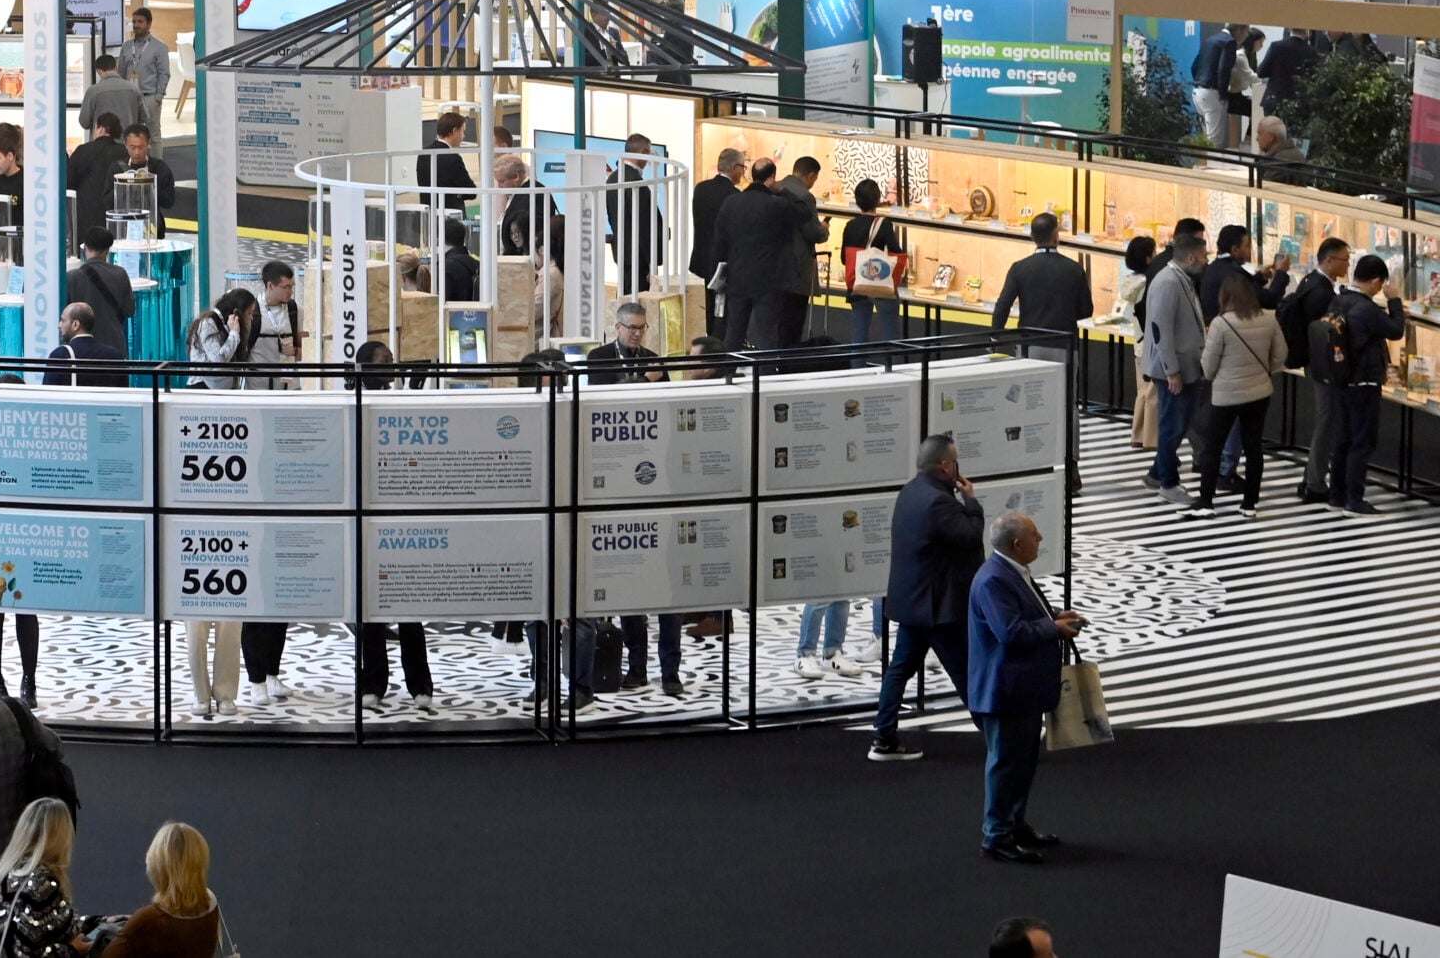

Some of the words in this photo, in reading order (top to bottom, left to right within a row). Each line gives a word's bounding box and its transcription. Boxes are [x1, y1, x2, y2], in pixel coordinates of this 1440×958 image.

[33, 10, 49, 153] AWARDS
[1006, 64, 1077, 85] engagée
[342, 243, 356, 303] TOUR
[378, 416, 414, 428] PRIX
[418, 416, 450, 428] TOP
[591, 411, 630, 426] PRIX
[635, 409, 658, 424] DU
[197, 422, 249, 441] 2100
[378, 429, 391, 446] 3
[398, 429, 450, 446] PAYS
[591, 424, 659, 442] PUBLIC
[12, 439, 88, 452] INNOVATION
[180, 441, 249, 450] INNOVATIONS
[2, 450, 25, 459] SIAL
[27, 450, 59, 460] PARIS
[61, 451, 89, 462] 2024
[180, 454, 248, 482] 560
[68, 526, 90, 539] TO
[180, 529, 197, 537] FOR
[197, 529, 215, 537] THIS
[378, 528, 396, 537] TOP
[398, 528, 404, 536] 3
[406, 528, 450, 536] COUNTRY
[591, 523, 614, 535] THE
[617, 521, 659, 534] PUBLIC
[7, 537, 64, 547] INNOVATION
[65, 540, 89, 548] AREA
[181, 536, 234, 555] 2,100
[238, 540, 248, 551] +
[377, 536, 450, 550] AWARDS
[591, 534, 659, 551] CHOICE
[5, 546, 28, 556] SIAL
[30, 548, 60, 558] PARIS
[63, 549, 89, 559] 2024
[180, 553, 250, 564] INNOVATIONS
[181, 568, 248, 596] 560
[181, 600, 200, 608] 2024
[200, 600, 248, 609] DISTINCTION
